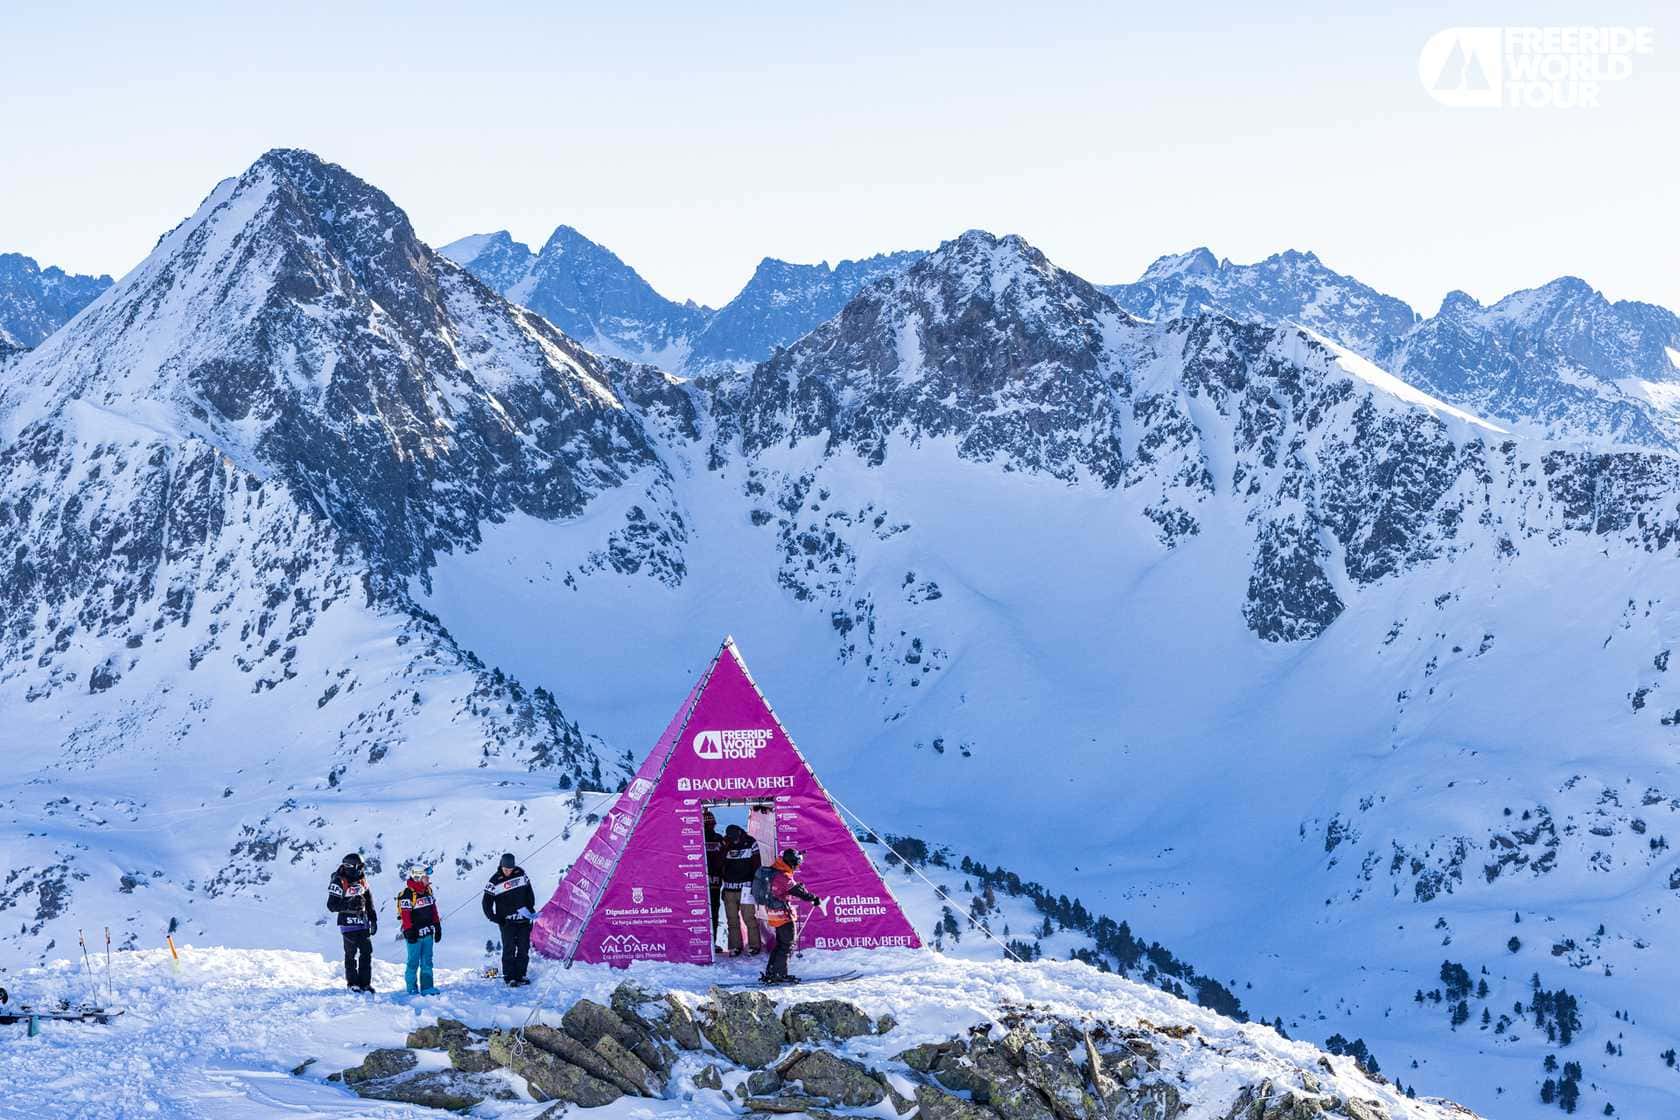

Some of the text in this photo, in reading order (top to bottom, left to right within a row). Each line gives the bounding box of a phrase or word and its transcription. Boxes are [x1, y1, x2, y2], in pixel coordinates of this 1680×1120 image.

[721, 729, 774, 740] FREERIDE
[721, 739, 767, 750] WORLD
[722, 749, 757, 760] TOUR
[833, 894, 881, 906] Catalana
[605, 907, 640, 917] Diputació
[650, 906, 673, 914] Lleida
[834, 906, 887, 917] Occidente
[835, 916, 862, 924] Seguros
[599, 943, 667, 954] VAL D'ARAN
